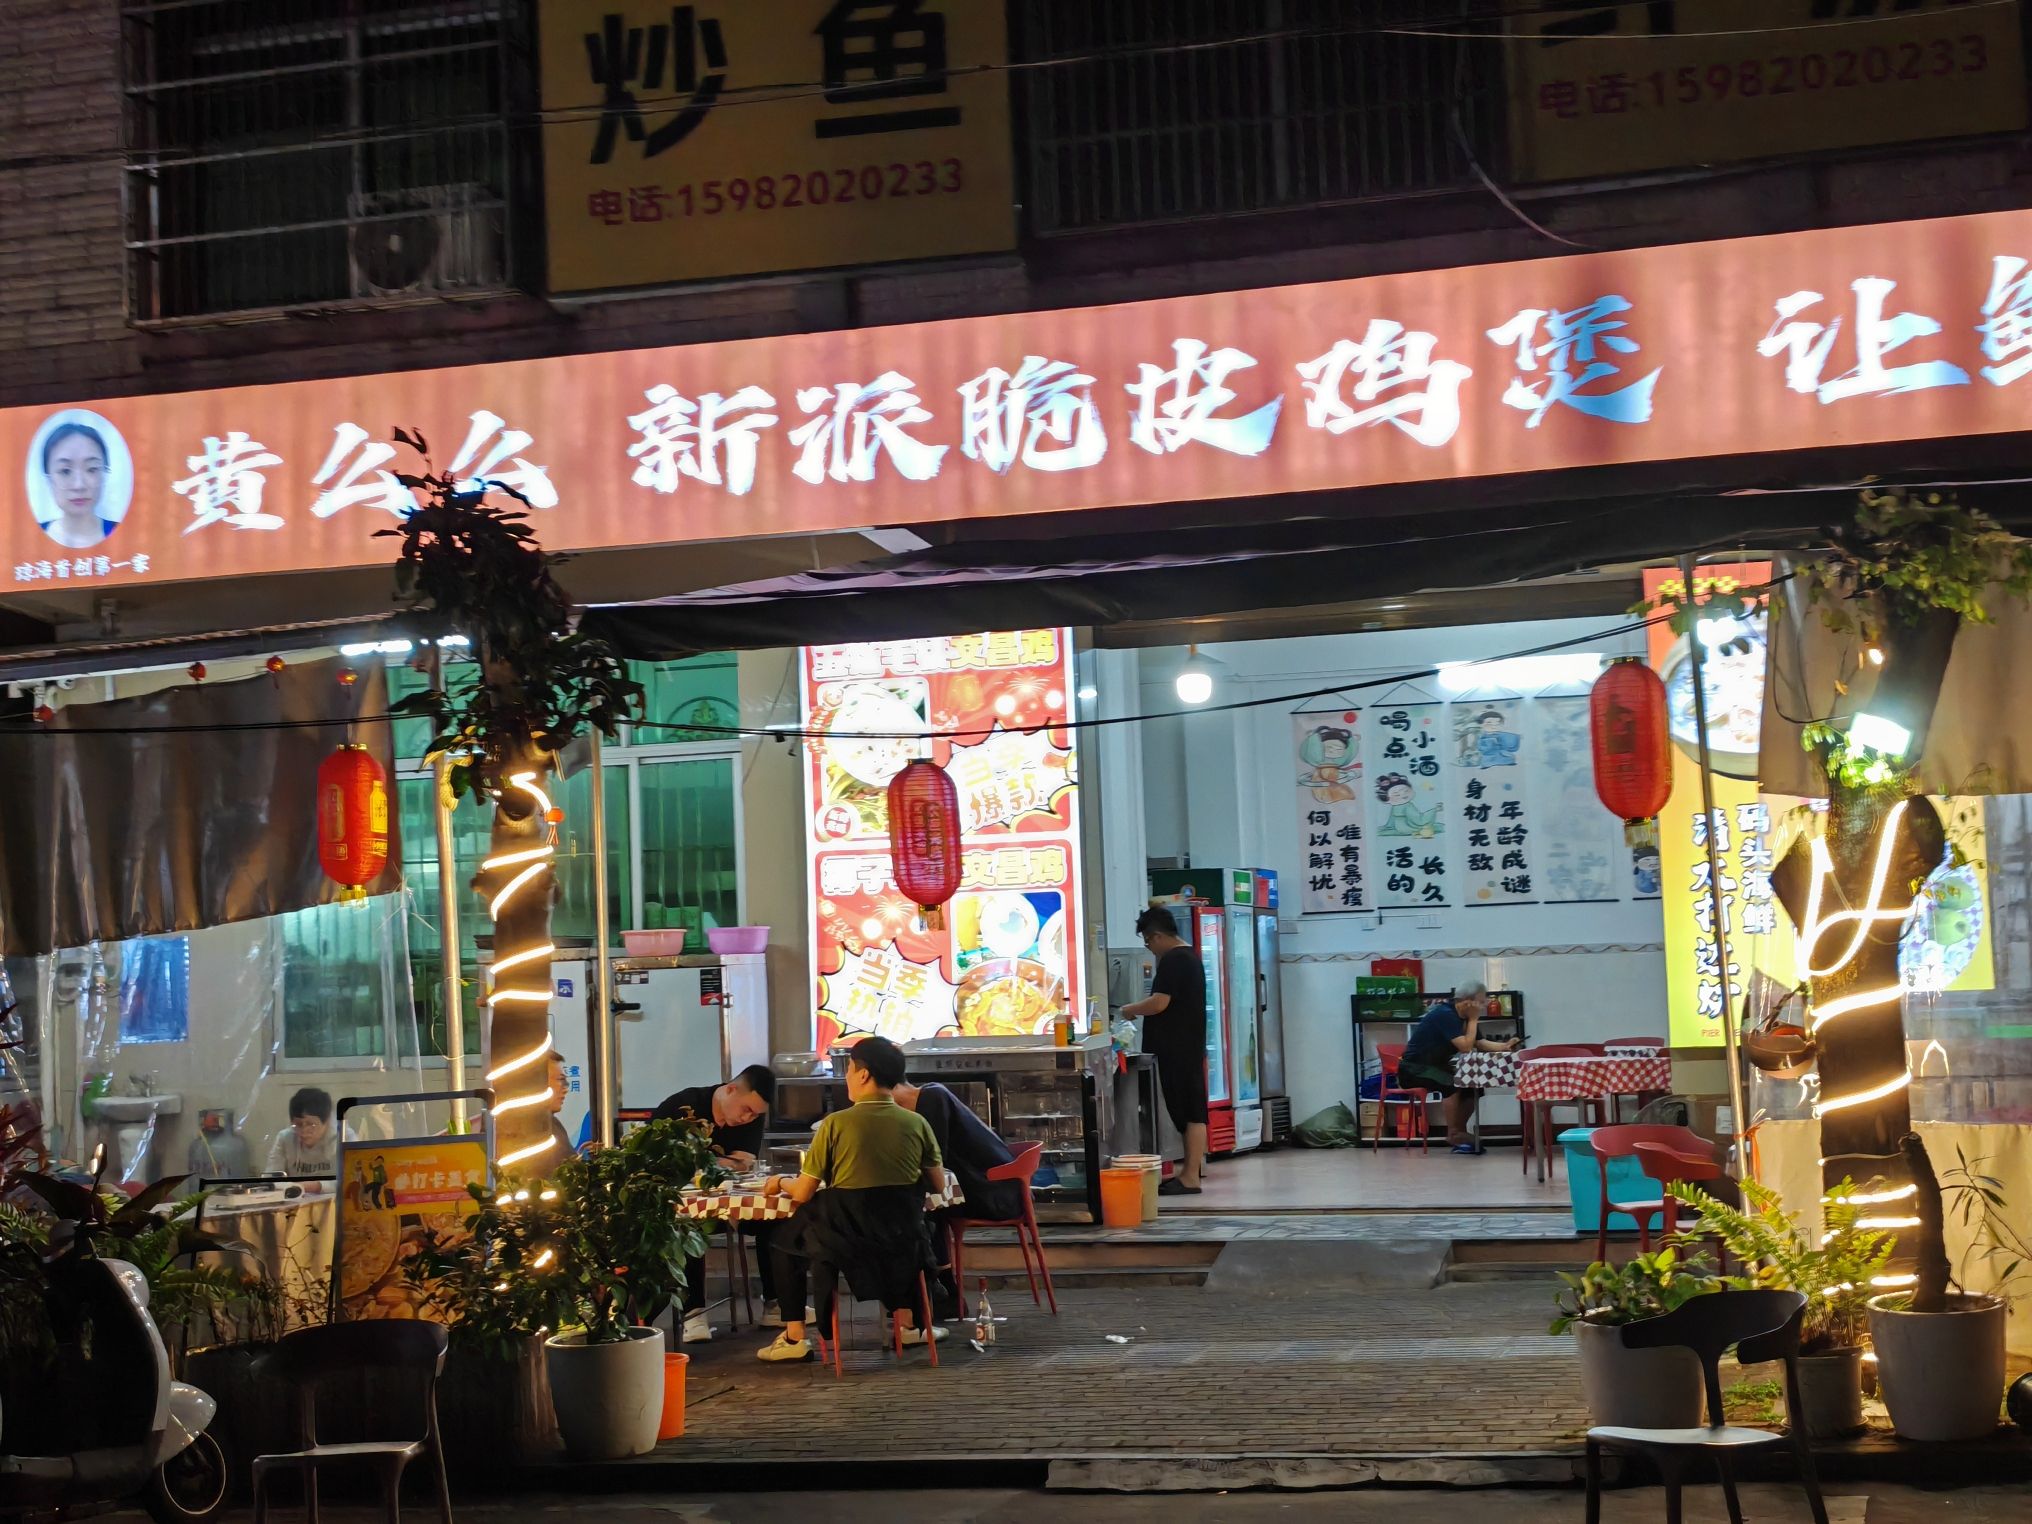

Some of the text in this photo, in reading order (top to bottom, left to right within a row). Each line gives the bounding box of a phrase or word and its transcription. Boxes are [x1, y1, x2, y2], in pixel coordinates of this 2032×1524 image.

[1538, 33, 1991, 119] 电话:15982020233
[588, 157, 963, 226] 电话:15982020233
[627, 294, 1663, 495] 新派脆皮鸡煲
[1380, 711, 1411, 758] 喝点
[1307, 810, 1336, 892] 何以解忧
[1336, 824, 1363, 907] 唯有暴瘦
[1463, 777, 1494, 871] 身材无敌
[1496, 801, 1531, 893] 年龄成谜
[1387, 846, 1415, 893] 活的
[1418, 856, 1446, 902] 长久
[1735, 803, 1777, 935] 码头海鲜
